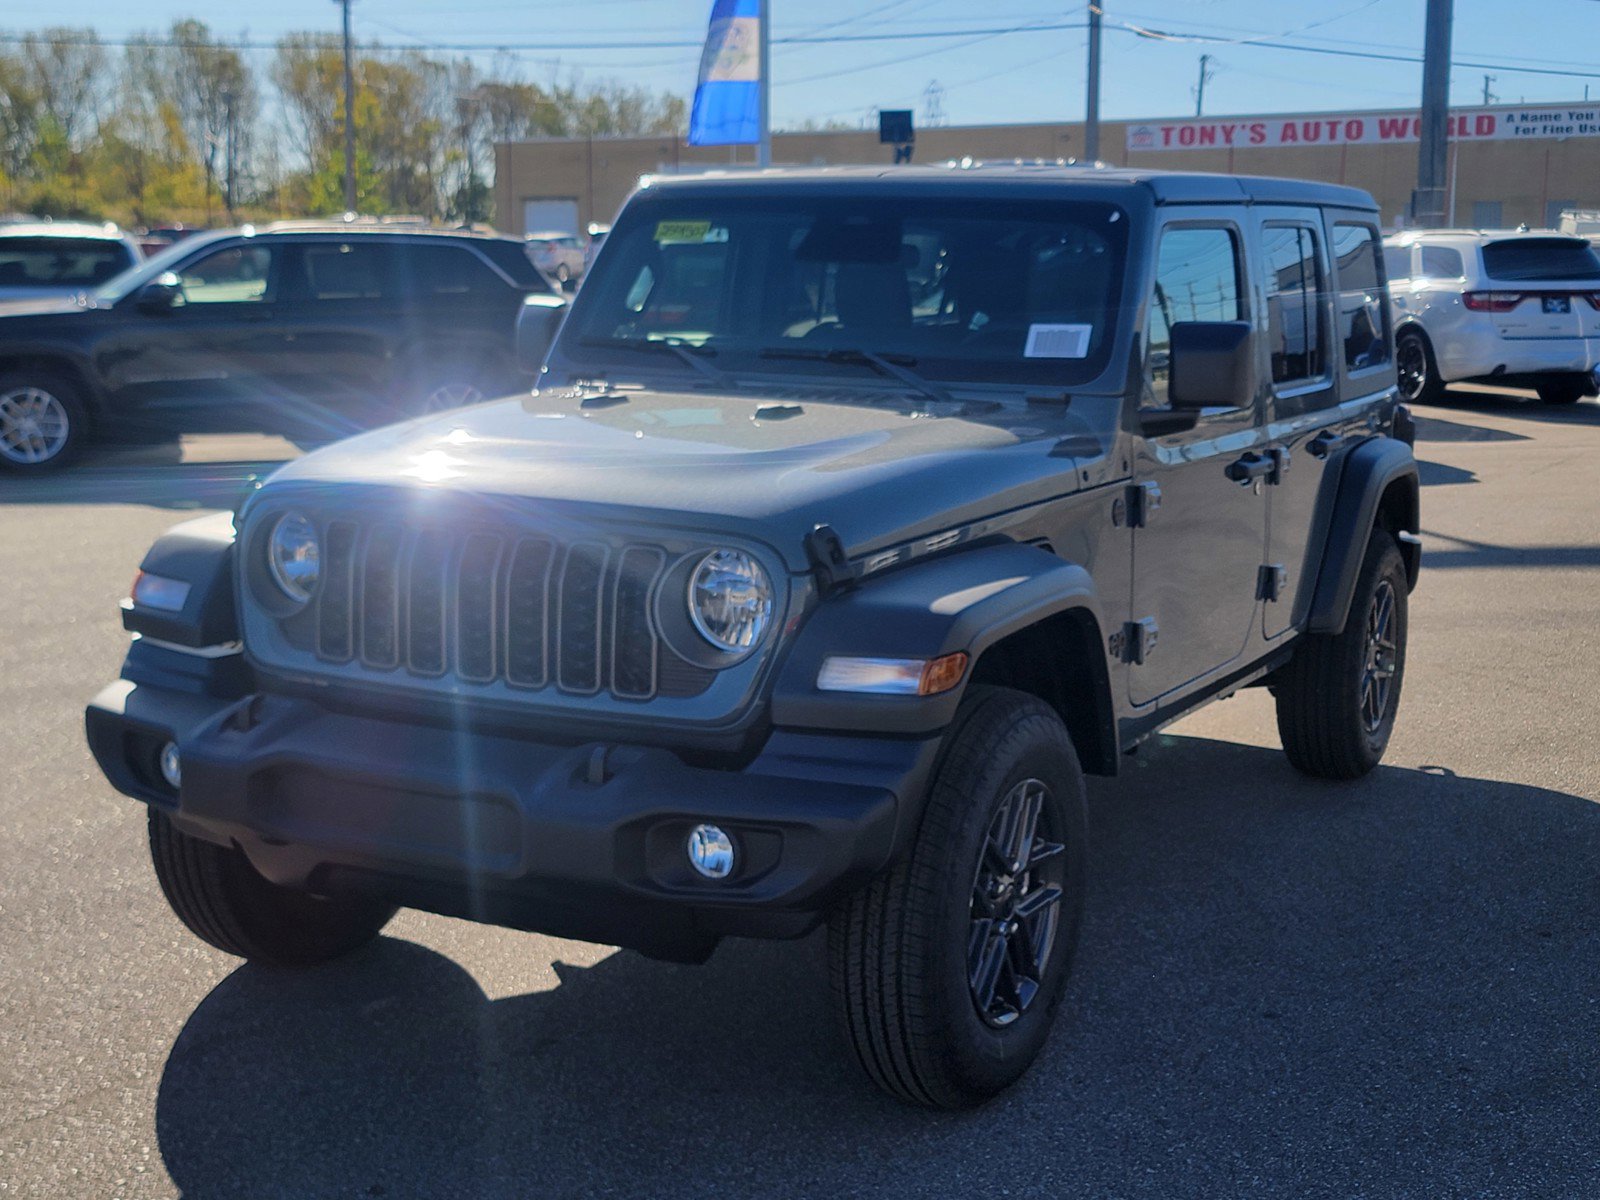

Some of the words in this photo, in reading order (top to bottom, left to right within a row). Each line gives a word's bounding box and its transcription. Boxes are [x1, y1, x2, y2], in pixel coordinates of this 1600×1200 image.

[1507, 114, 1514, 123] A
[1521, 113, 1561, 122] Name
[1569, 112, 1594, 121] You
[1161, 124, 1266, 146] TONY'S
[1281, 120, 1363, 142] AUTO
[1515, 126, 1536, 135] For
[1543, 124, 1574, 134] Fine
